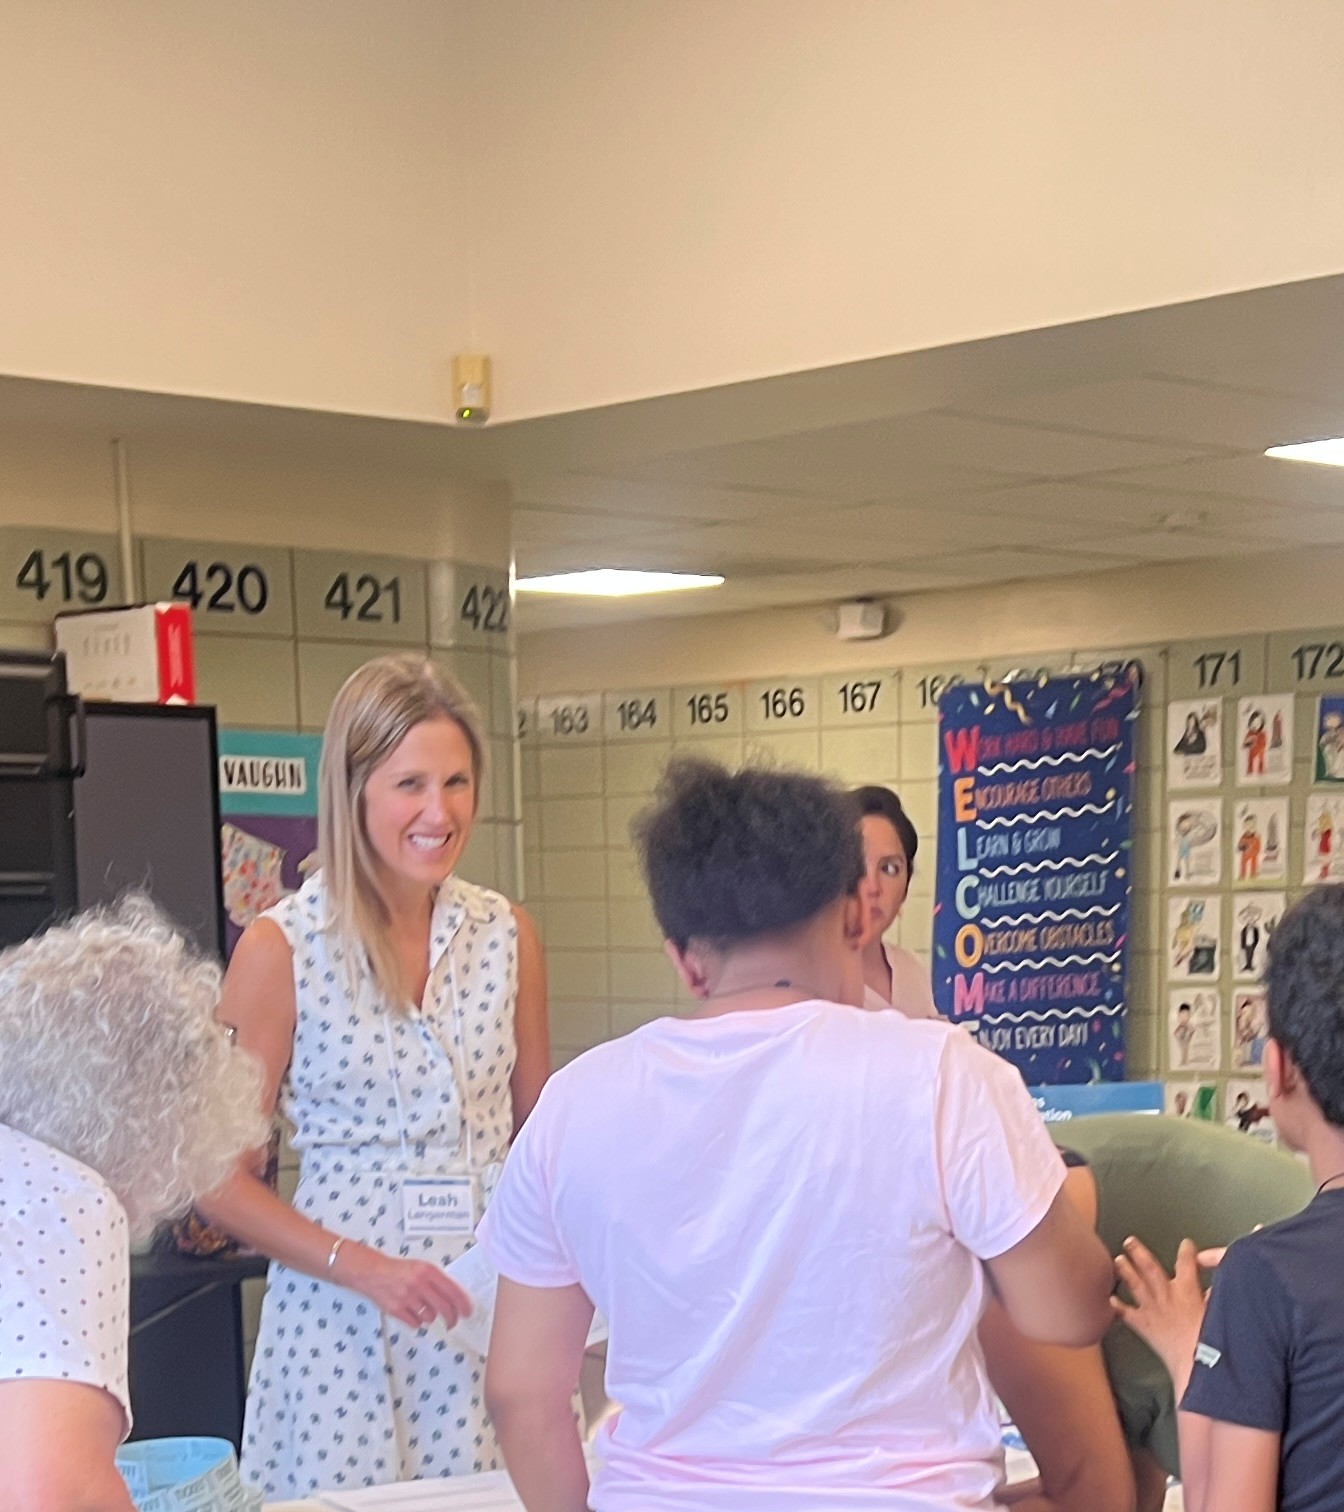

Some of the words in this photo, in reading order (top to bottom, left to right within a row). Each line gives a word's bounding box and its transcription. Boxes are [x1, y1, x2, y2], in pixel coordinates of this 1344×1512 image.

[16, 549, 109, 602] 419
[172, 561, 269, 614] 420
[324, 572, 402, 624] 421
[1193, 651, 1241, 690] 171
[617, 697, 657, 731] 164
[687, 690, 729, 726] 165
[760, 687, 805, 720] 166
[839, 680, 882, 714] 167
[549, 704, 589, 736] 163
[223, 759, 303, 789] VAUGHN
[1015, 1023, 1055, 1050] EVERY
[418, 1193, 457, 1207] Leah
